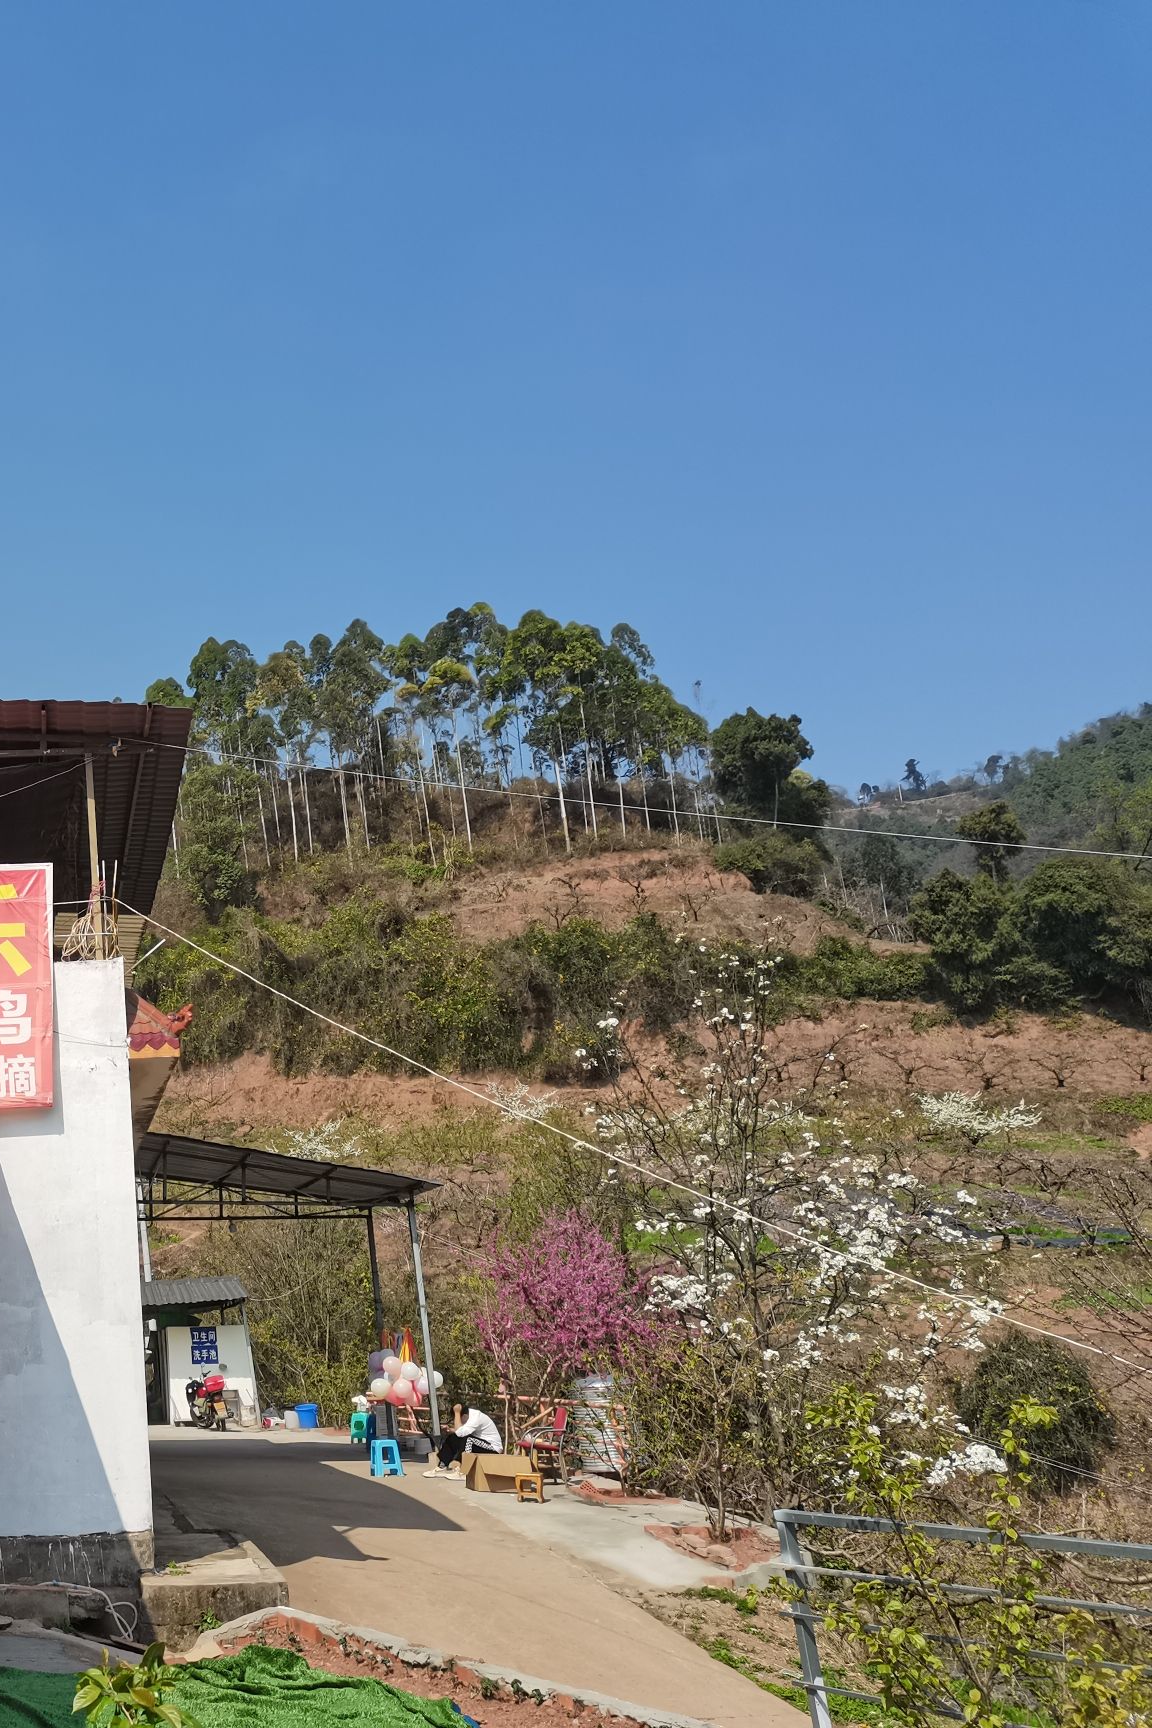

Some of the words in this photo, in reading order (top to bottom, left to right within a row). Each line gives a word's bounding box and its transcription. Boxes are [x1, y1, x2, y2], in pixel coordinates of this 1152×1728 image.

[192, 1331, 216, 1342] 卫生间
[193, 1349, 217, 1361] 洗手池
